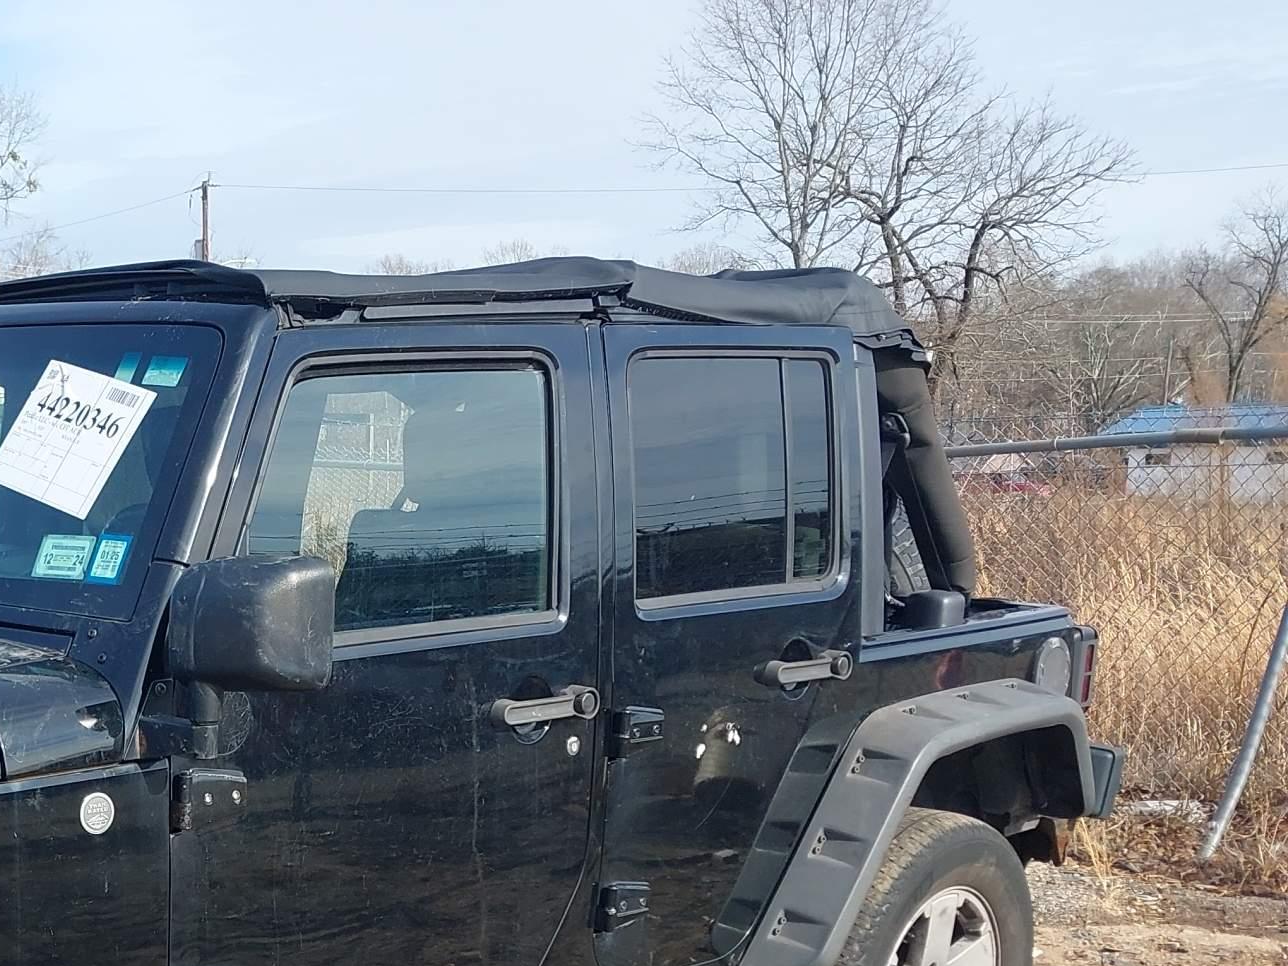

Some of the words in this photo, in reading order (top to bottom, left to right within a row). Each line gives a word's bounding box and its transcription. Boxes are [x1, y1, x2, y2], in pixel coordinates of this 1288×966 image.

[37, 391, 127, 439] 44220346
[43, 552, 54, 565] 12
[72, 554, 85, 566] 24
